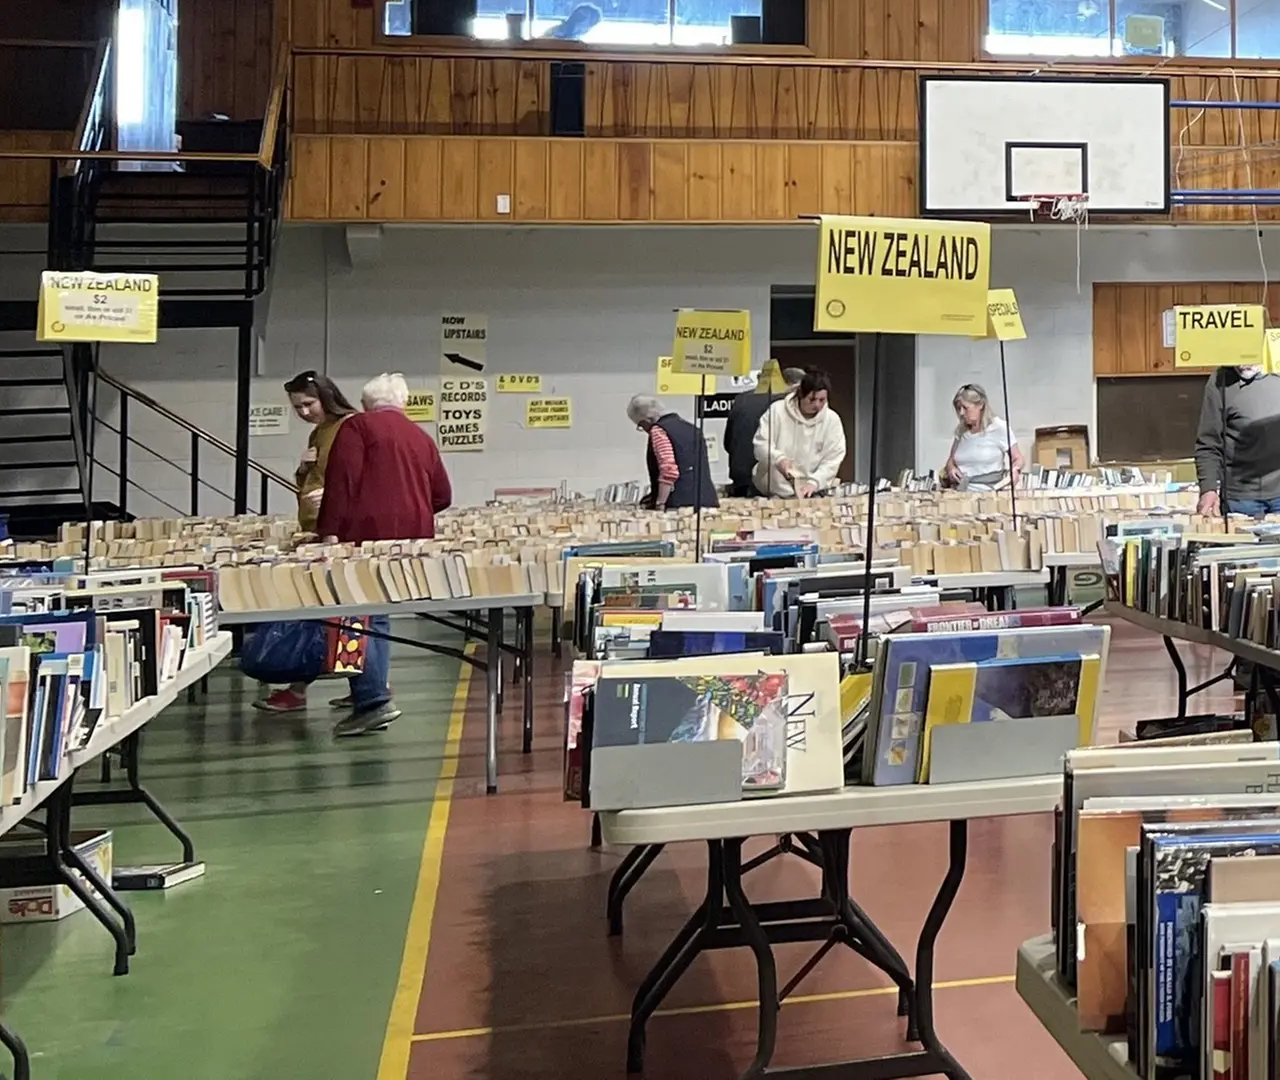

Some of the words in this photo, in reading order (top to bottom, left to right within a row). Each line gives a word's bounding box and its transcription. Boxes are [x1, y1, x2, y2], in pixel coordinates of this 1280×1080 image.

[828, 229, 877, 275] NEW
[881, 232, 979, 280] ZEALAND
[50, 276, 83, 290] NEW
[87, 278, 152, 293] ZEALAND
[988, 303, 1019, 316] SPECIALS
[1179, 310, 1254, 329] TRAVEL
[444, 329, 486, 340] UPSTAIRS
[676, 327, 698, 339] NEW
[699, 328, 745, 341] ZEALAND
[704, 344, 714, 354] $2
[443, 382, 454, 390] C
[459, 381, 485, 390] D'S
[406, 394, 434, 407] SAWS
[441, 392, 487, 403] RECORDS
[262, 406, 283, 416] CARE
[703, 400, 735, 412] LADI
[443, 409, 482, 420] TOYS
[439, 423, 479, 435] GAMES
[441, 434, 484, 446] PUZZLES
[927, 619, 972, 632] FRONTIER
[632, 683, 641, 705] Annual
[629, 705, 640, 729] Report
[786, 691, 815, 753] NEW
[8, 898, 53, 918] Dole
